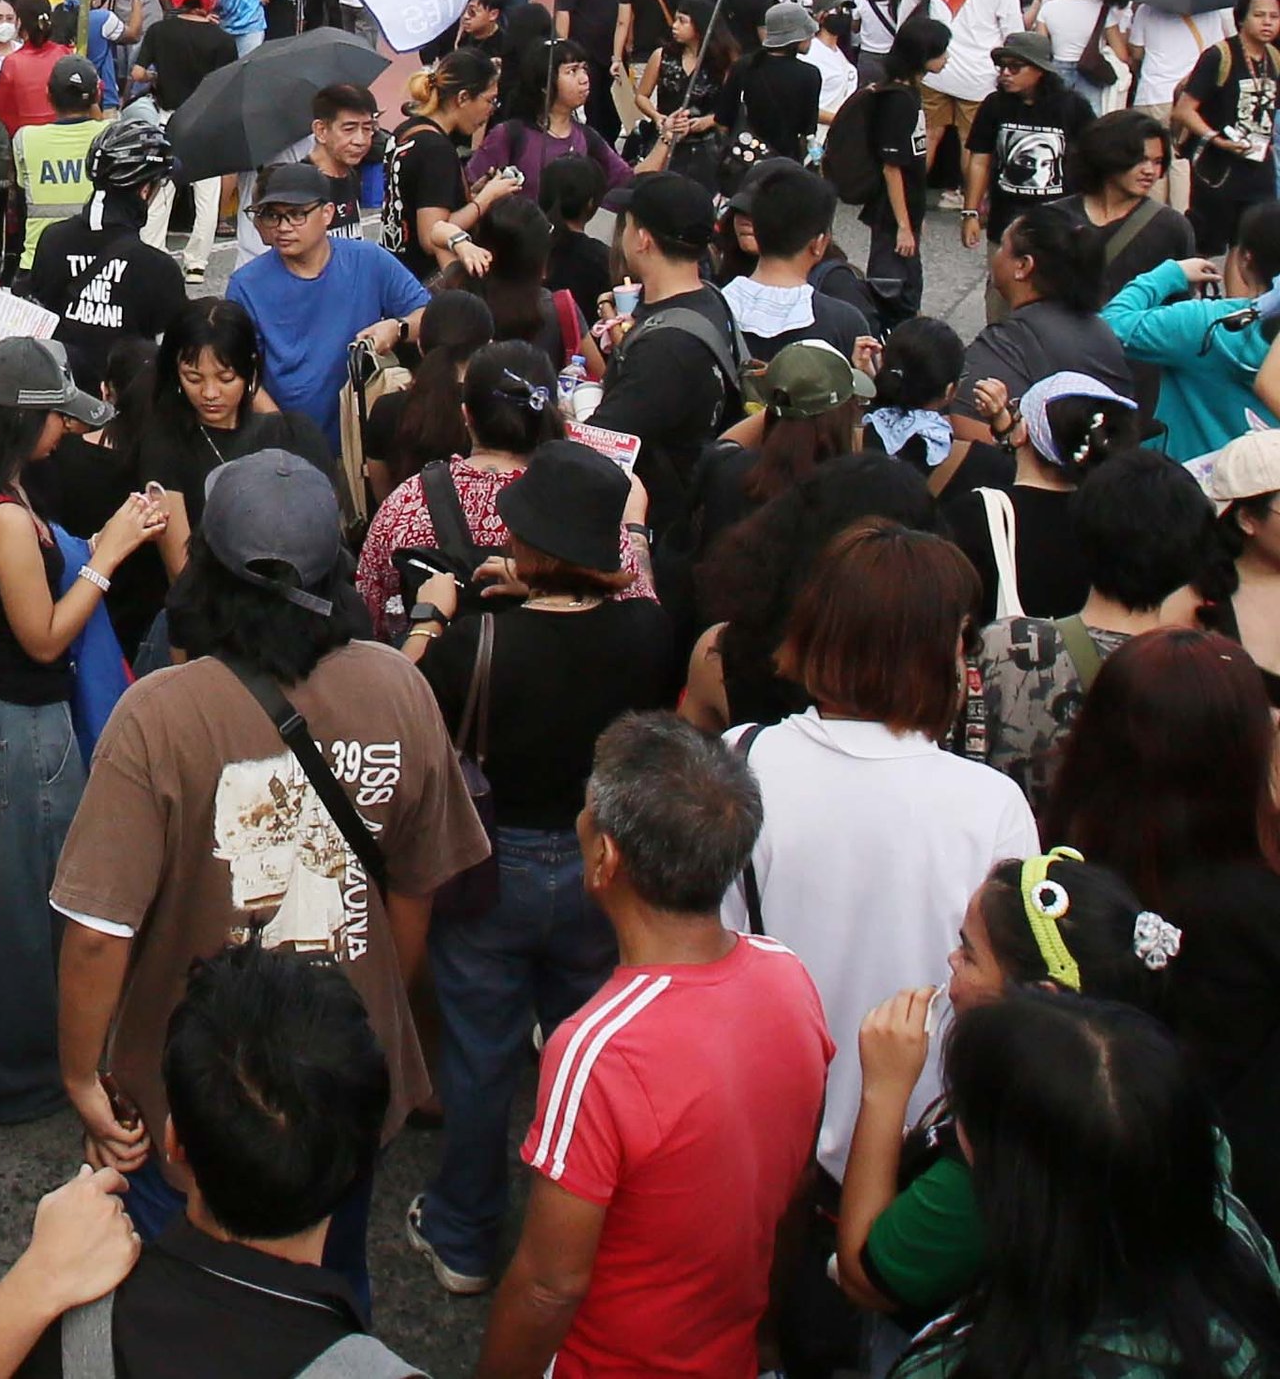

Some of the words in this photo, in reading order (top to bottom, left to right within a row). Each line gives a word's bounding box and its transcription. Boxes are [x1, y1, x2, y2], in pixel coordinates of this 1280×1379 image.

[80, 278, 112, 304] ANG
[65, 301, 124, 328] LABAN!
[355, 740, 402, 807] USS
